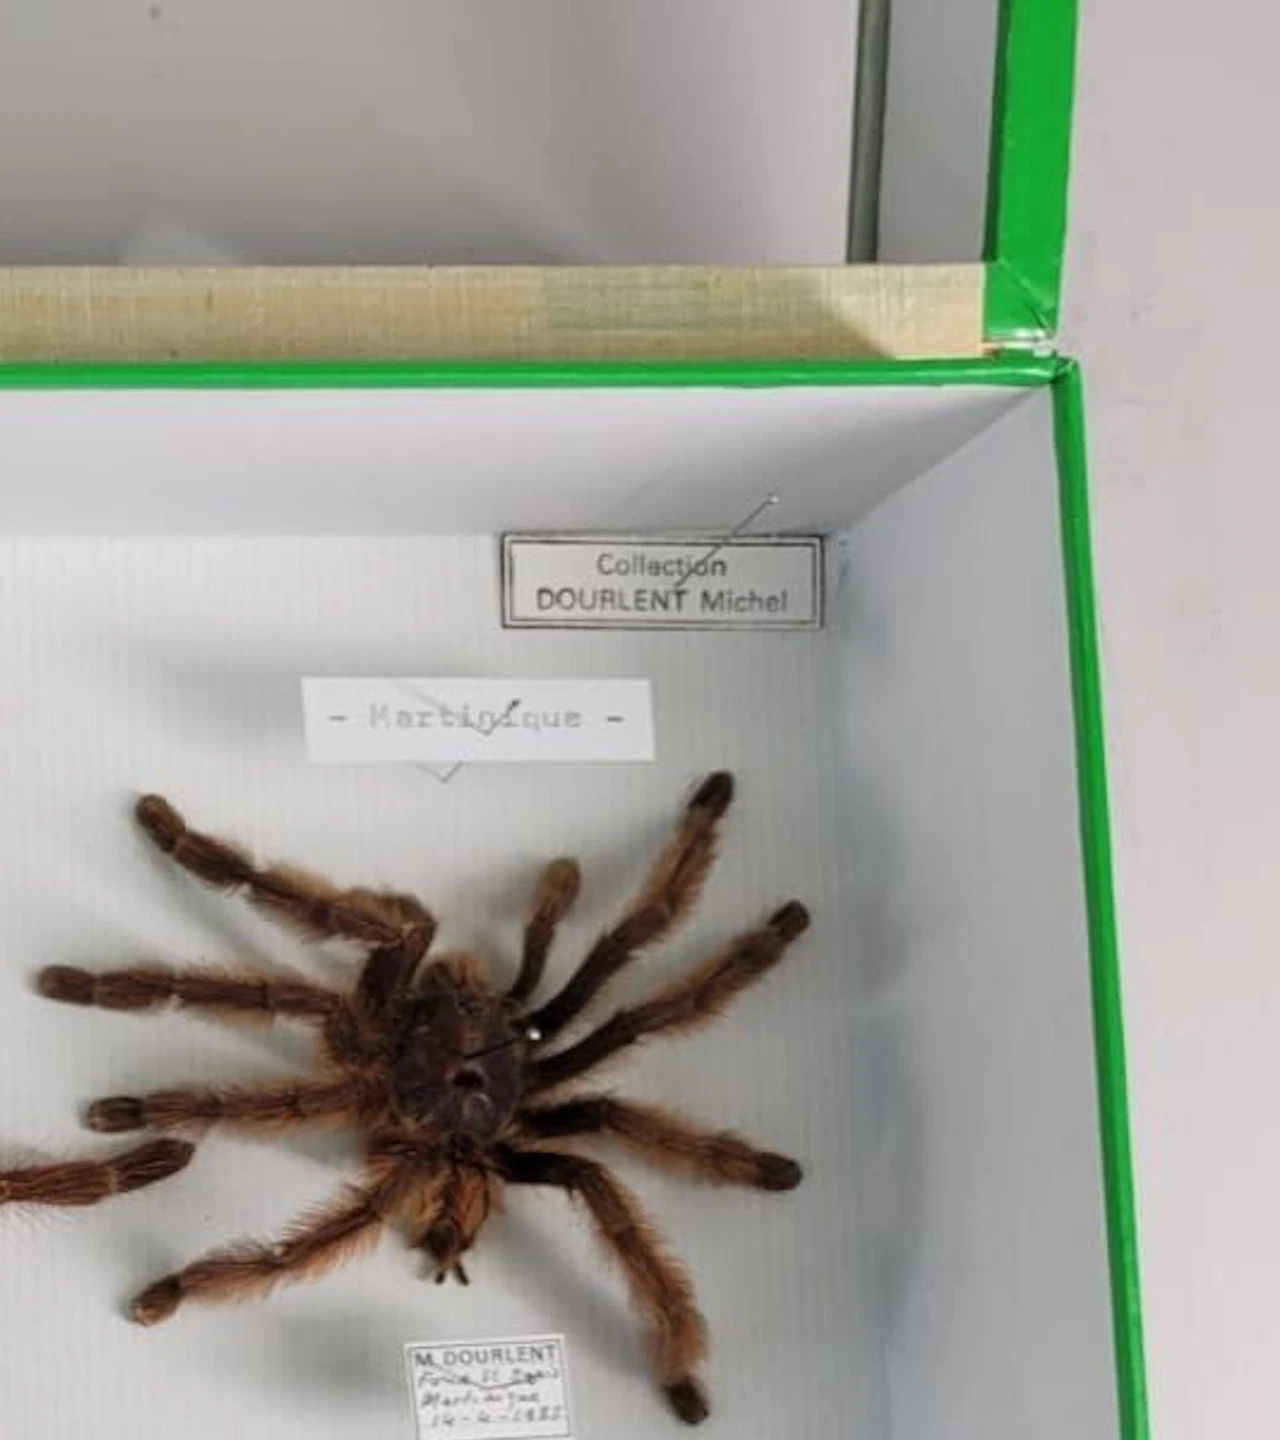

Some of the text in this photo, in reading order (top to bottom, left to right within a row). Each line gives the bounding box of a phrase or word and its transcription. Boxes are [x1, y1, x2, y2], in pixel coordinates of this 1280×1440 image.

[596, 553, 728, 577] Collection
[536, 587, 788, 613] DOURLENT Michel
[369, 703, 582, 733] Martinique
[443, 1344, 556, 1366] DOURLENT
